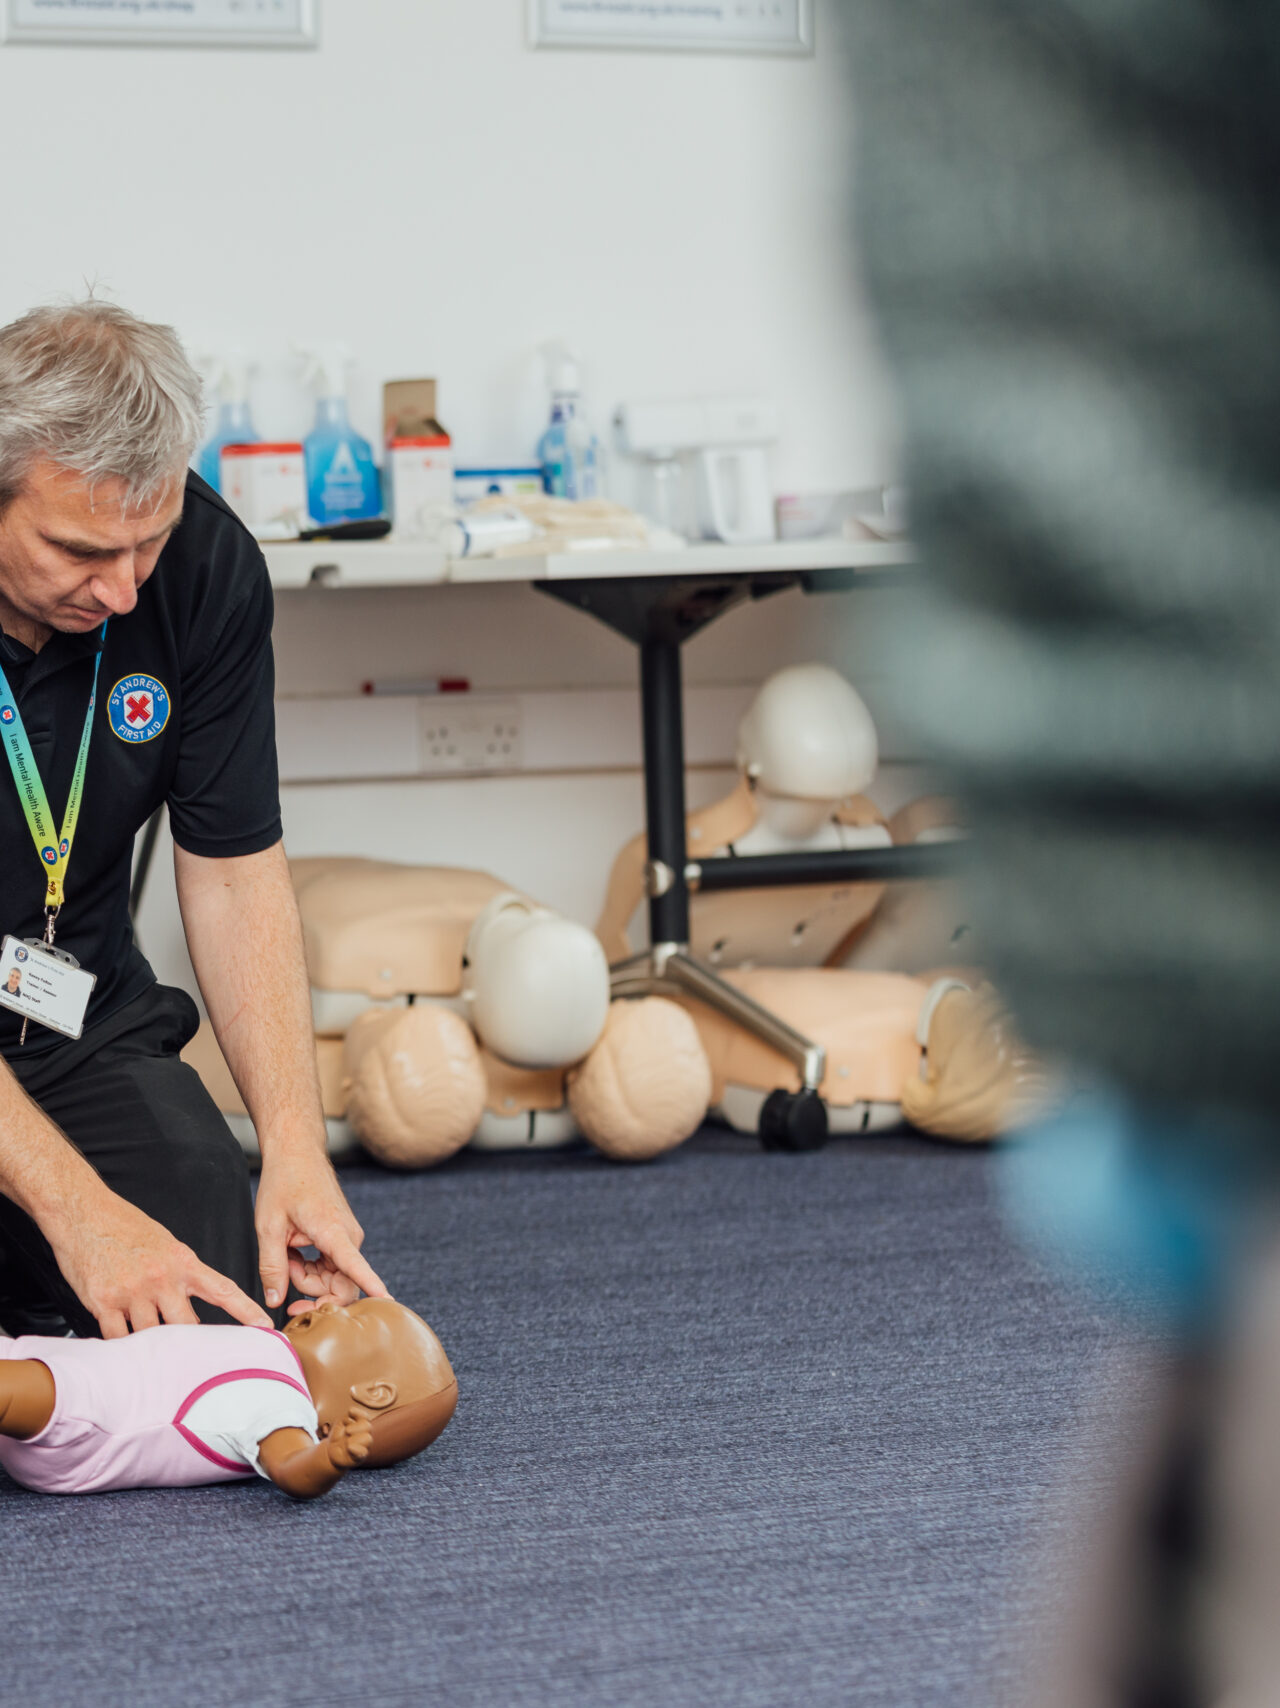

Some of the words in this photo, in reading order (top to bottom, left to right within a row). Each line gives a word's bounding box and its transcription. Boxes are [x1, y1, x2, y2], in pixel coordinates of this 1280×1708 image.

[111, 692, 122, 706] ST
[120, 678, 166, 702] ANDREW'S
[118, 724, 144, 740] FIRST
[147, 721, 161, 737] AID
[10, 738, 20, 752] am
[15, 752, 31, 782] Mental
[24, 782, 39, 810] Health
[32, 811, 46, 837] Aware
